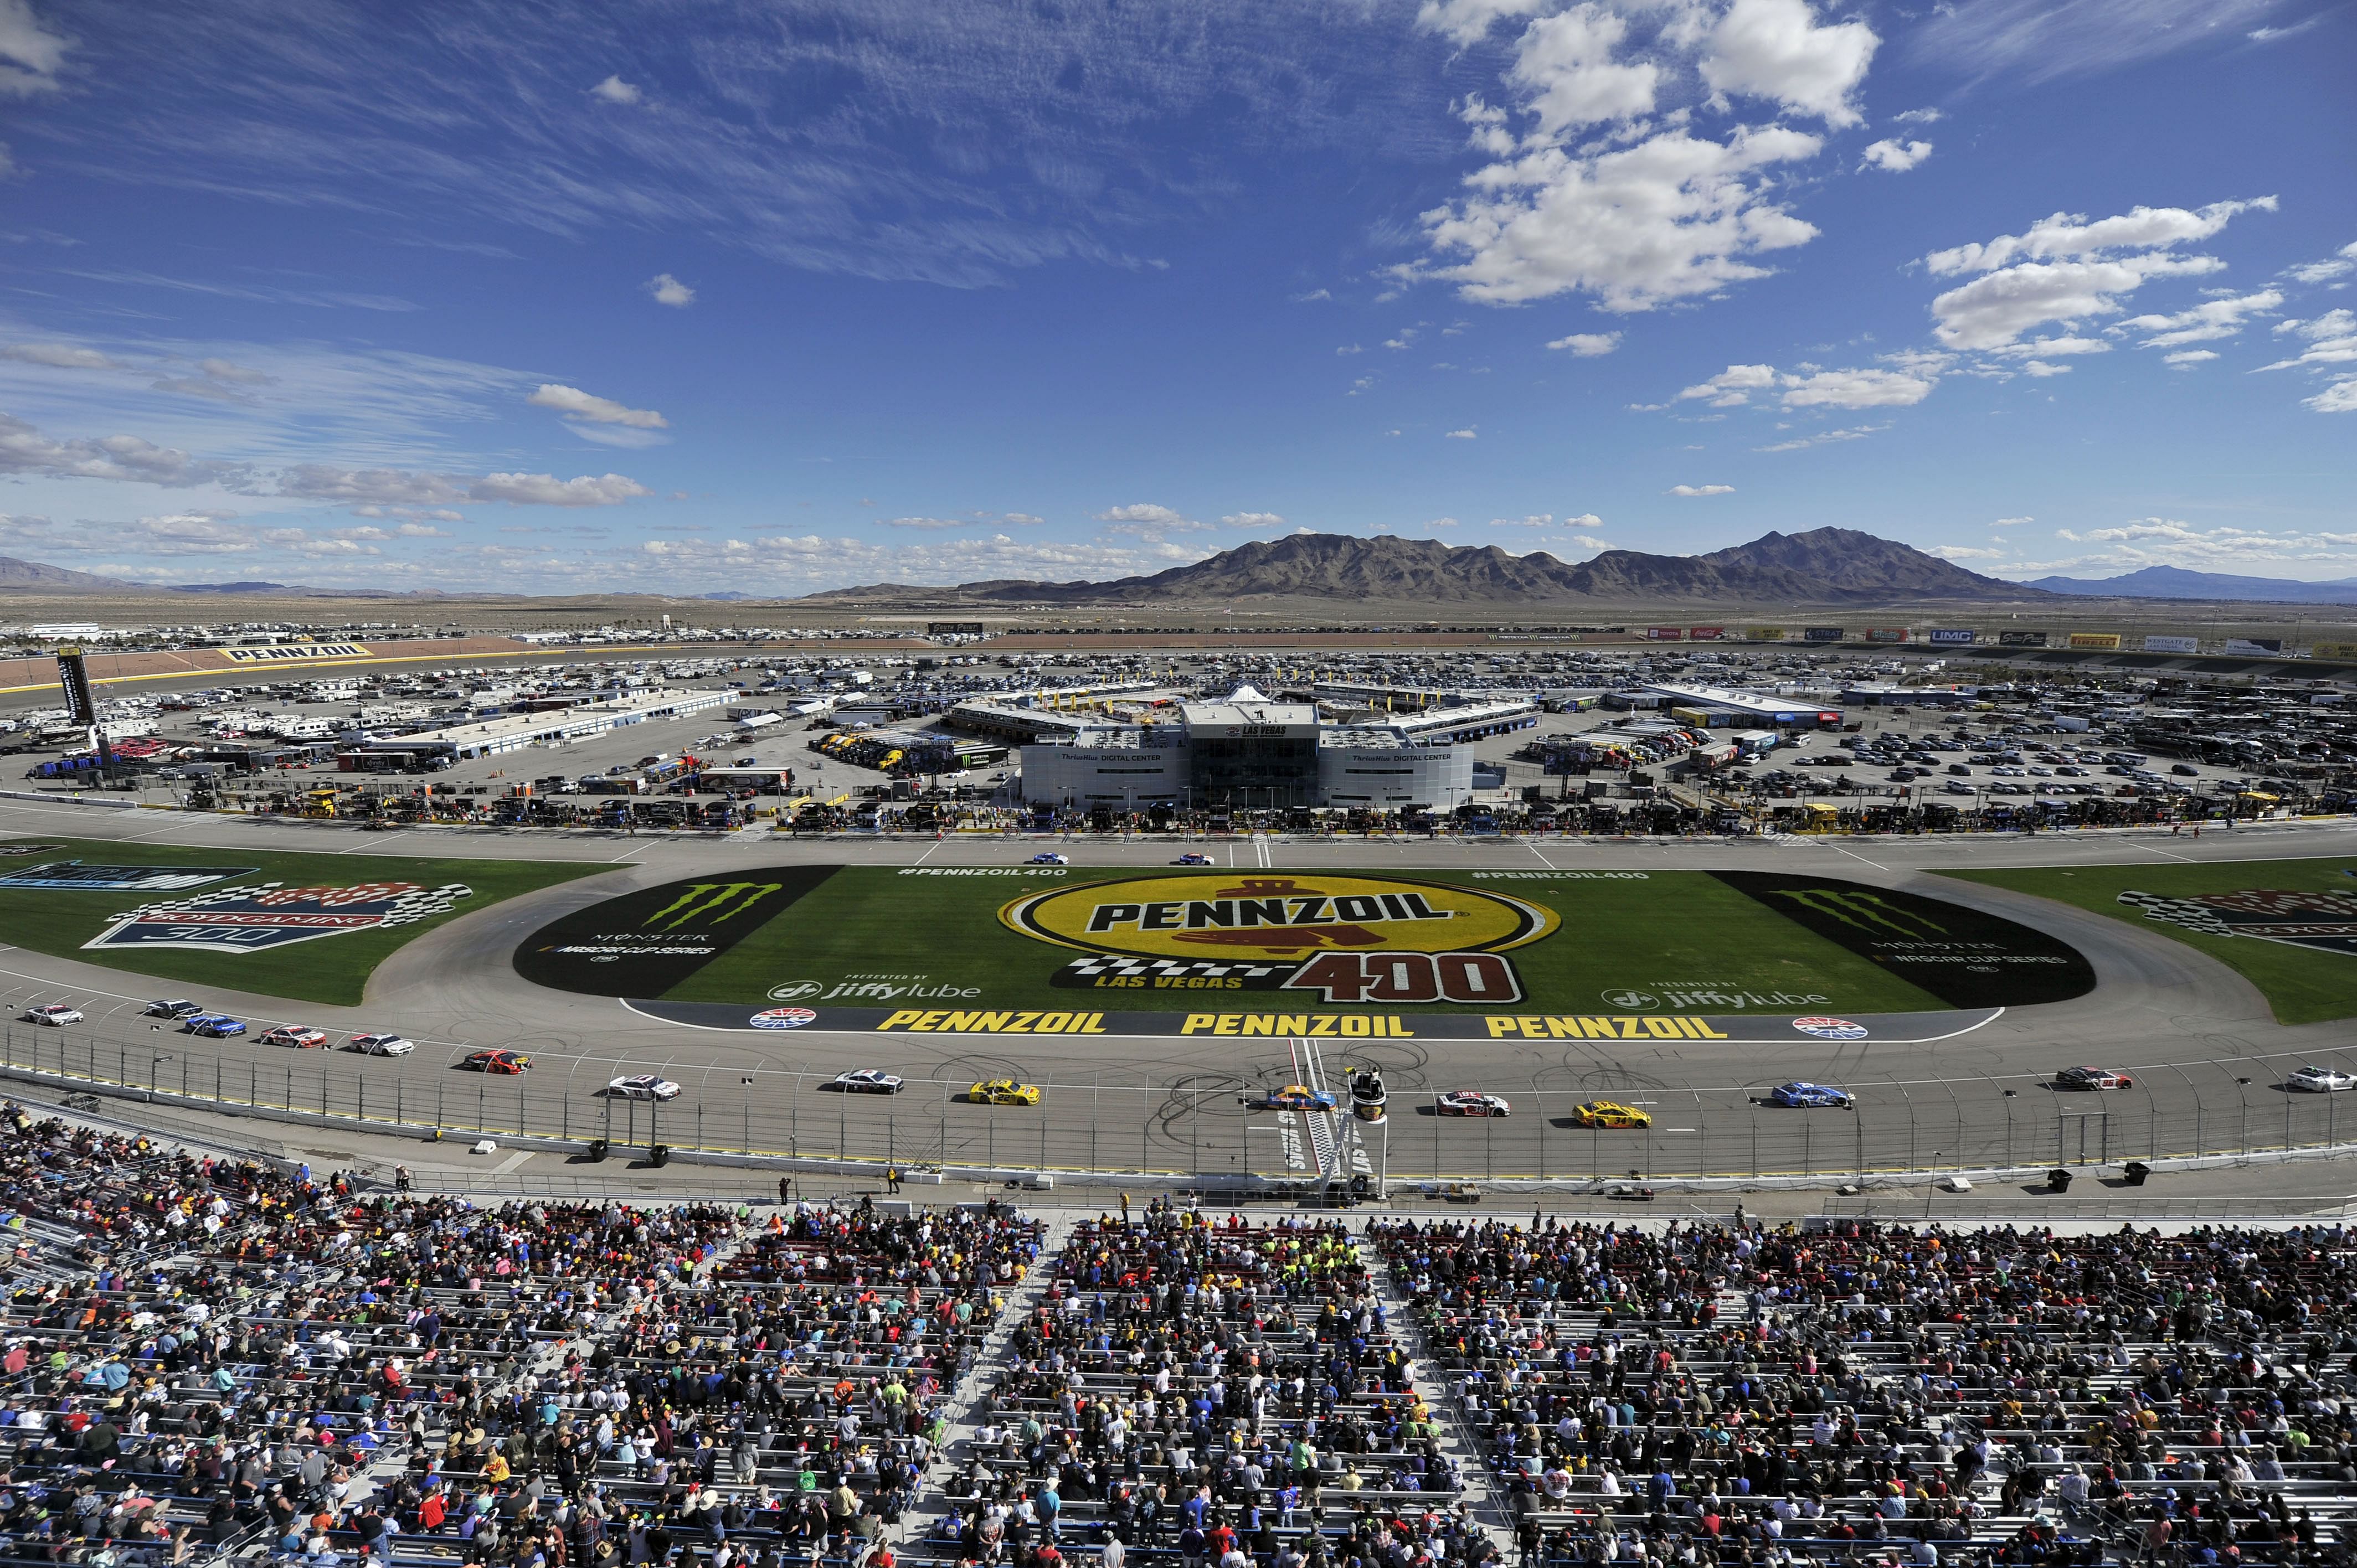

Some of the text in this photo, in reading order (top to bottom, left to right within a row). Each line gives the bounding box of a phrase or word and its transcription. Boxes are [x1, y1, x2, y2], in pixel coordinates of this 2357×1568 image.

[957, 623, 977, 632] POINT
[1932, 632, 1971, 642] UMC
[2071, 637, 2116, 646] PIRELLI
[228, 644, 365, 661] PENNZOIL
[1243, 726, 1286, 735] LAS VEGAS
[146, 911, 378, 925] BOYDGAMING
[1084, 893, 1454, 932] PENNZOIL
[141, 927, 281, 941] 300
[2001, 956, 2068, 964] SERIES
[1094, 976, 1243, 988] LAS VEGAS
[1280, 951, 1523, 1004] 400
[876, 1010, 1107, 1034] PENNZOIL
[1180, 1014, 1414, 1037] PENNZOIL
[1484, 1016, 1728, 1039] PENNZOIL
[1301, 1098, 1305, 1107] 1
[1816, 1095, 1826, 1103] 42
[1614, 1116, 1627, 1125] 34
[1280, 1128, 1306, 1170] VEGAS
